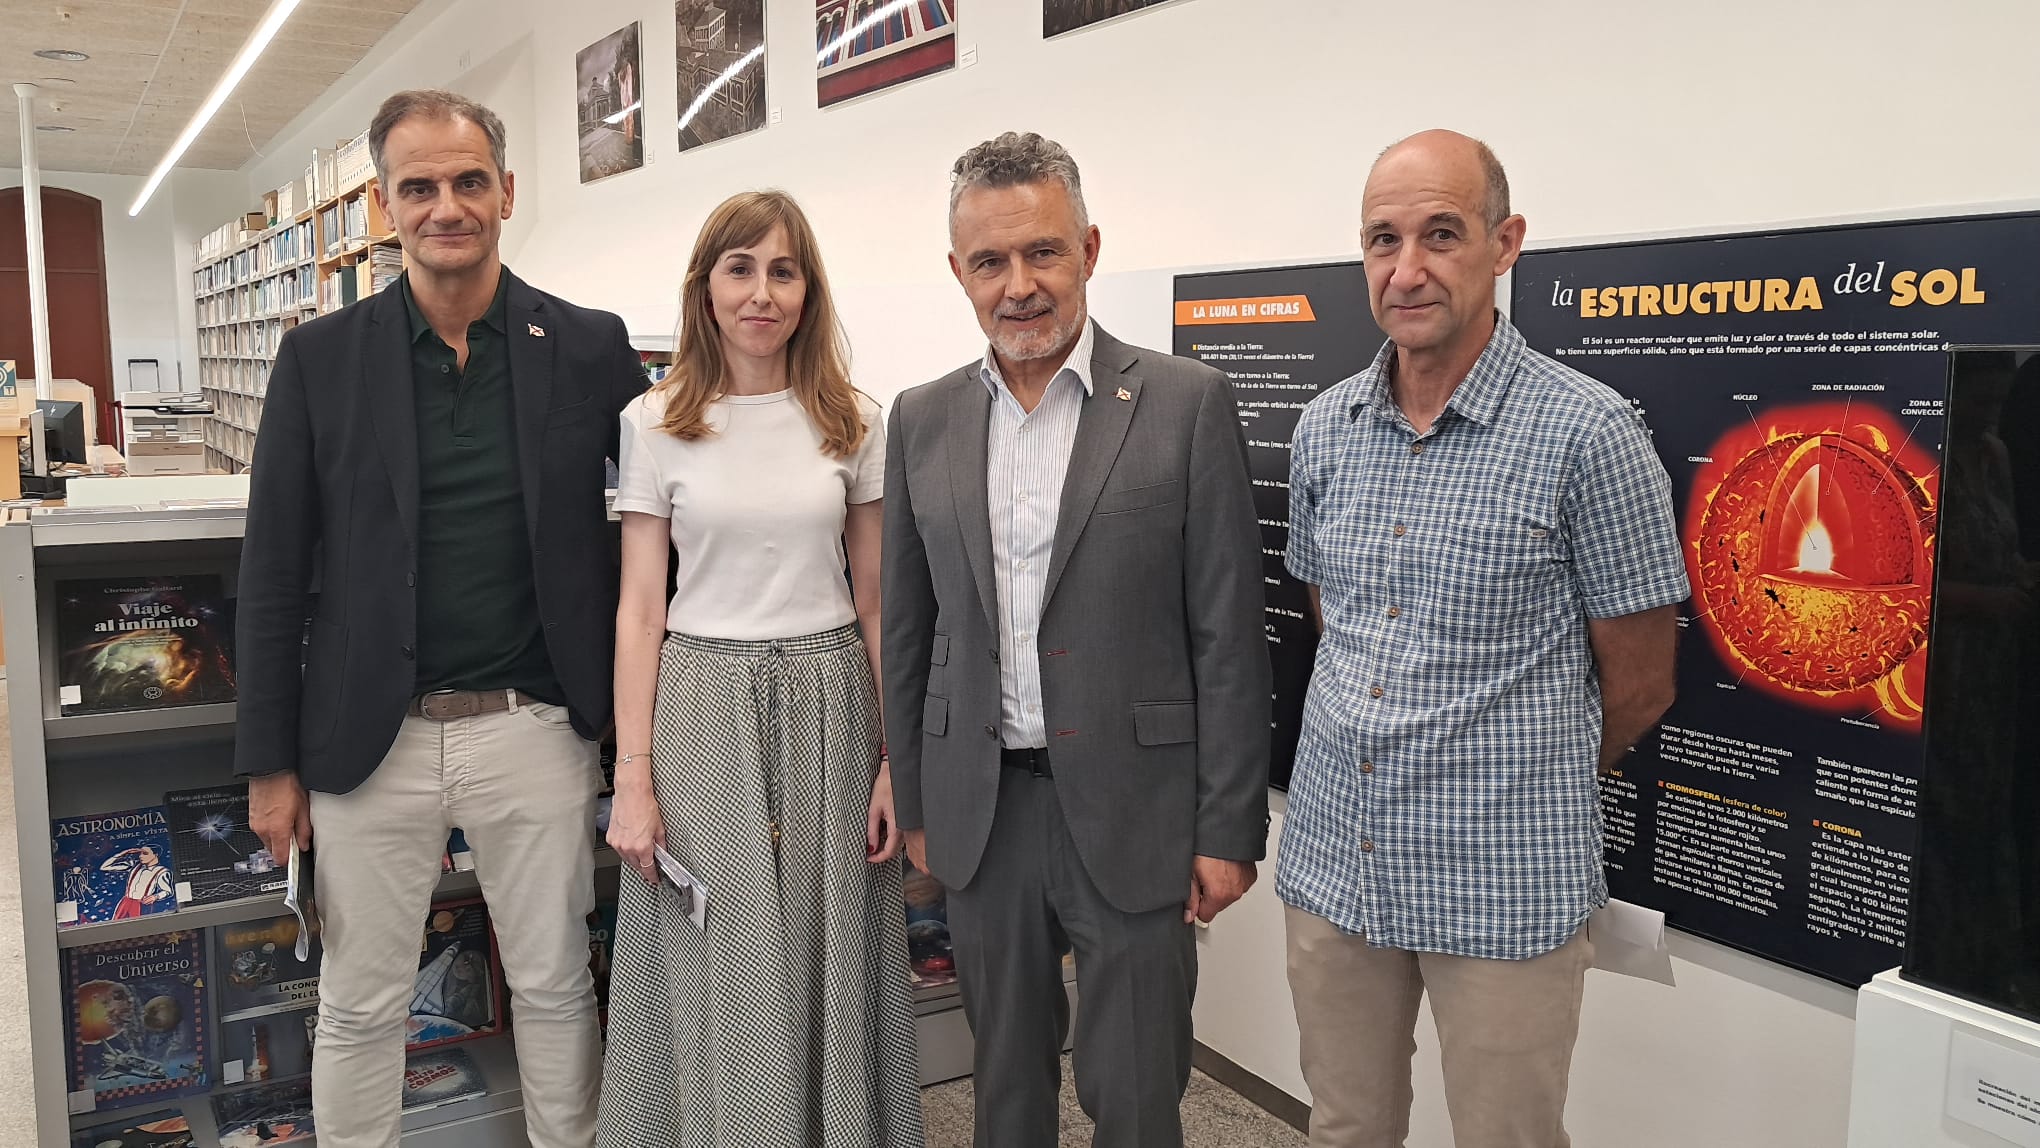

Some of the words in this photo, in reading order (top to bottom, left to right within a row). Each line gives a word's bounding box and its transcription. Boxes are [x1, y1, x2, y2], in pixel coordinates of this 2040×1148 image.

[1551, 281, 1574, 307] la
[1579, 276, 1823, 318] ESTRUCTURA
[1833, 261, 1885, 295] del
[1888, 267, 1985, 307] SOL
[1193, 306, 1206, 318] LA
[1209, 305, 1238, 318] LUNA
[1241, 304, 1256, 317] EN
[1260, 302, 1300, 316] CIFRAS
[1582, 337, 1590, 345] El
[1591, 337, 1603, 345] Sol
[1626, 336, 1653, 344] reactor
[1655, 336, 1684, 344] nuclear
[1687, 336, 1703, 345] que
[1704, 335, 1729, 343] emite
[1731, 334, 1744, 342] luz
[1746, 335, 1751, 344] y
[1753, 333, 1776, 342] calor
[1786, 333, 1815, 341] través
[1816, 332, 1829, 341] de
[1832, 332, 1855, 341] todo
[1857, 331, 1867, 340] el
[1869, 331, 1909, 340] sistema
[1911, 330, 1939, 339] solar.
[1568, 347, 1586, 355] tiene
[1603, 347, 1641, 356] superficie
[1642, 346, 1668, 356] sólida,
[1688, 347, 1705, 356] que
[1706, 345, 1724, 354] está
[1726, 345, 1764, 354] formado
[1765, 346, 1782, 355] por
[1803, 344, 1827, 352] serie
[1829, 343, 1842, 352] de
[1844, 344, 1872, 354] capas
[1874, 342, 1939, 352] concéntricas
[1733, 393, 1758, 401] NÚCLEO
[1844, 383, 1885, 392] RADIACIÓN
[118, 602, 174, 617] Viaje
[94, 619, 114, 632] al
[118, 616, 199, 631] infinito
[1660, 733, 1681, 743] durar
[1682, 737, 1704, 748] desde
[1705, 742, 1727, 754] horas
[1728, 747, 1750, 759] hasta
[1752, 754, 1779, 766] meses,
[1661, 724, 1681, 733] como
[1683, 728, 1714, 741] regiones
[1715, 735, 1745, 747] oscuras
[1746, 741, 1761, 751] que
[1762, 745, 1793, 758] pueden
[1660, 742, 1665, 750] y
[1666, 745, 1684, 754] cuyo
[1685, 747, 1714, 760] tamaño
[1715, 755, 1740, 766] puede
[1741, 760, 1754, 769] ser
[1755, 764, 1780, 775] varias
[1817, 756, 1851, 771] También
[1852, 764, 1891, 779] aparecen
[1892, 773, 1905, 782] las
[1616, 780, 1637, 790] emite
[1816, 768, 1832, 777] que
[1833, 772, 1849, 780] son
[1850, 775, 1889, 790] potentes
[1604, 785, 1626, 797] visible
[1627, 791, 1638, 800] del
[1665, 782, 1721, 801] CROMOSFERA
[1722, 796, 1750, 809] (esfera
[1751, 804, 1762, 812] de
[1763, 806, 1787, 819] color)
[1815, 779, 1848, 792] caliente
[1850, 786, 1861, 794] en
[1862, 788, 1889, 801] forma
[1890, 795, 1902, 804] de
[1815, 788, 1847, 802] tamaño
[1848, 797, 1865, 806] que
[1867, 800, 1879, 810] las
[1665, 791, 1674, 800] Se
[1675, 794, 1706, 808] extiende
[1707, 803, 1725, 813] unos
[1726, 807, 1746, 818] 2.000
[1747, 810, 1789, 829] kilómetros
[1610, 815, 1636, 828] aunque
[1822, 821, 1862, 838] CORONA
[1613, 843, 1626, 854] hay
[1821, 831, 1832, 840] Es
[1833, 834, 1842, 843] la
[1844, 839, 1865, 850] capa
[1866, 844, 1885, 855] más
[1811, 841, 1850, 856] extiende
[1860, 852, 1869, 861] lo
[1871, 855, 1895, 868] largo
[1897, 863, 1909, 872] de
[1808, 903, 1839, 918] mucho,
[1841, 911, 1866, 925] hasta
[1807, 913, 1858, 934] centígrados
[1860, 929, 1866, 937] y
[1868, 931, 1895, 945] emite
[1807, 923, 1830, 936] rayos
[95, 948, 159, 967] Descubrir
[164, 943, 176, 955] el
[119, 958, 190, 980] Universo
[292, 992, 307, 1000] DEL
